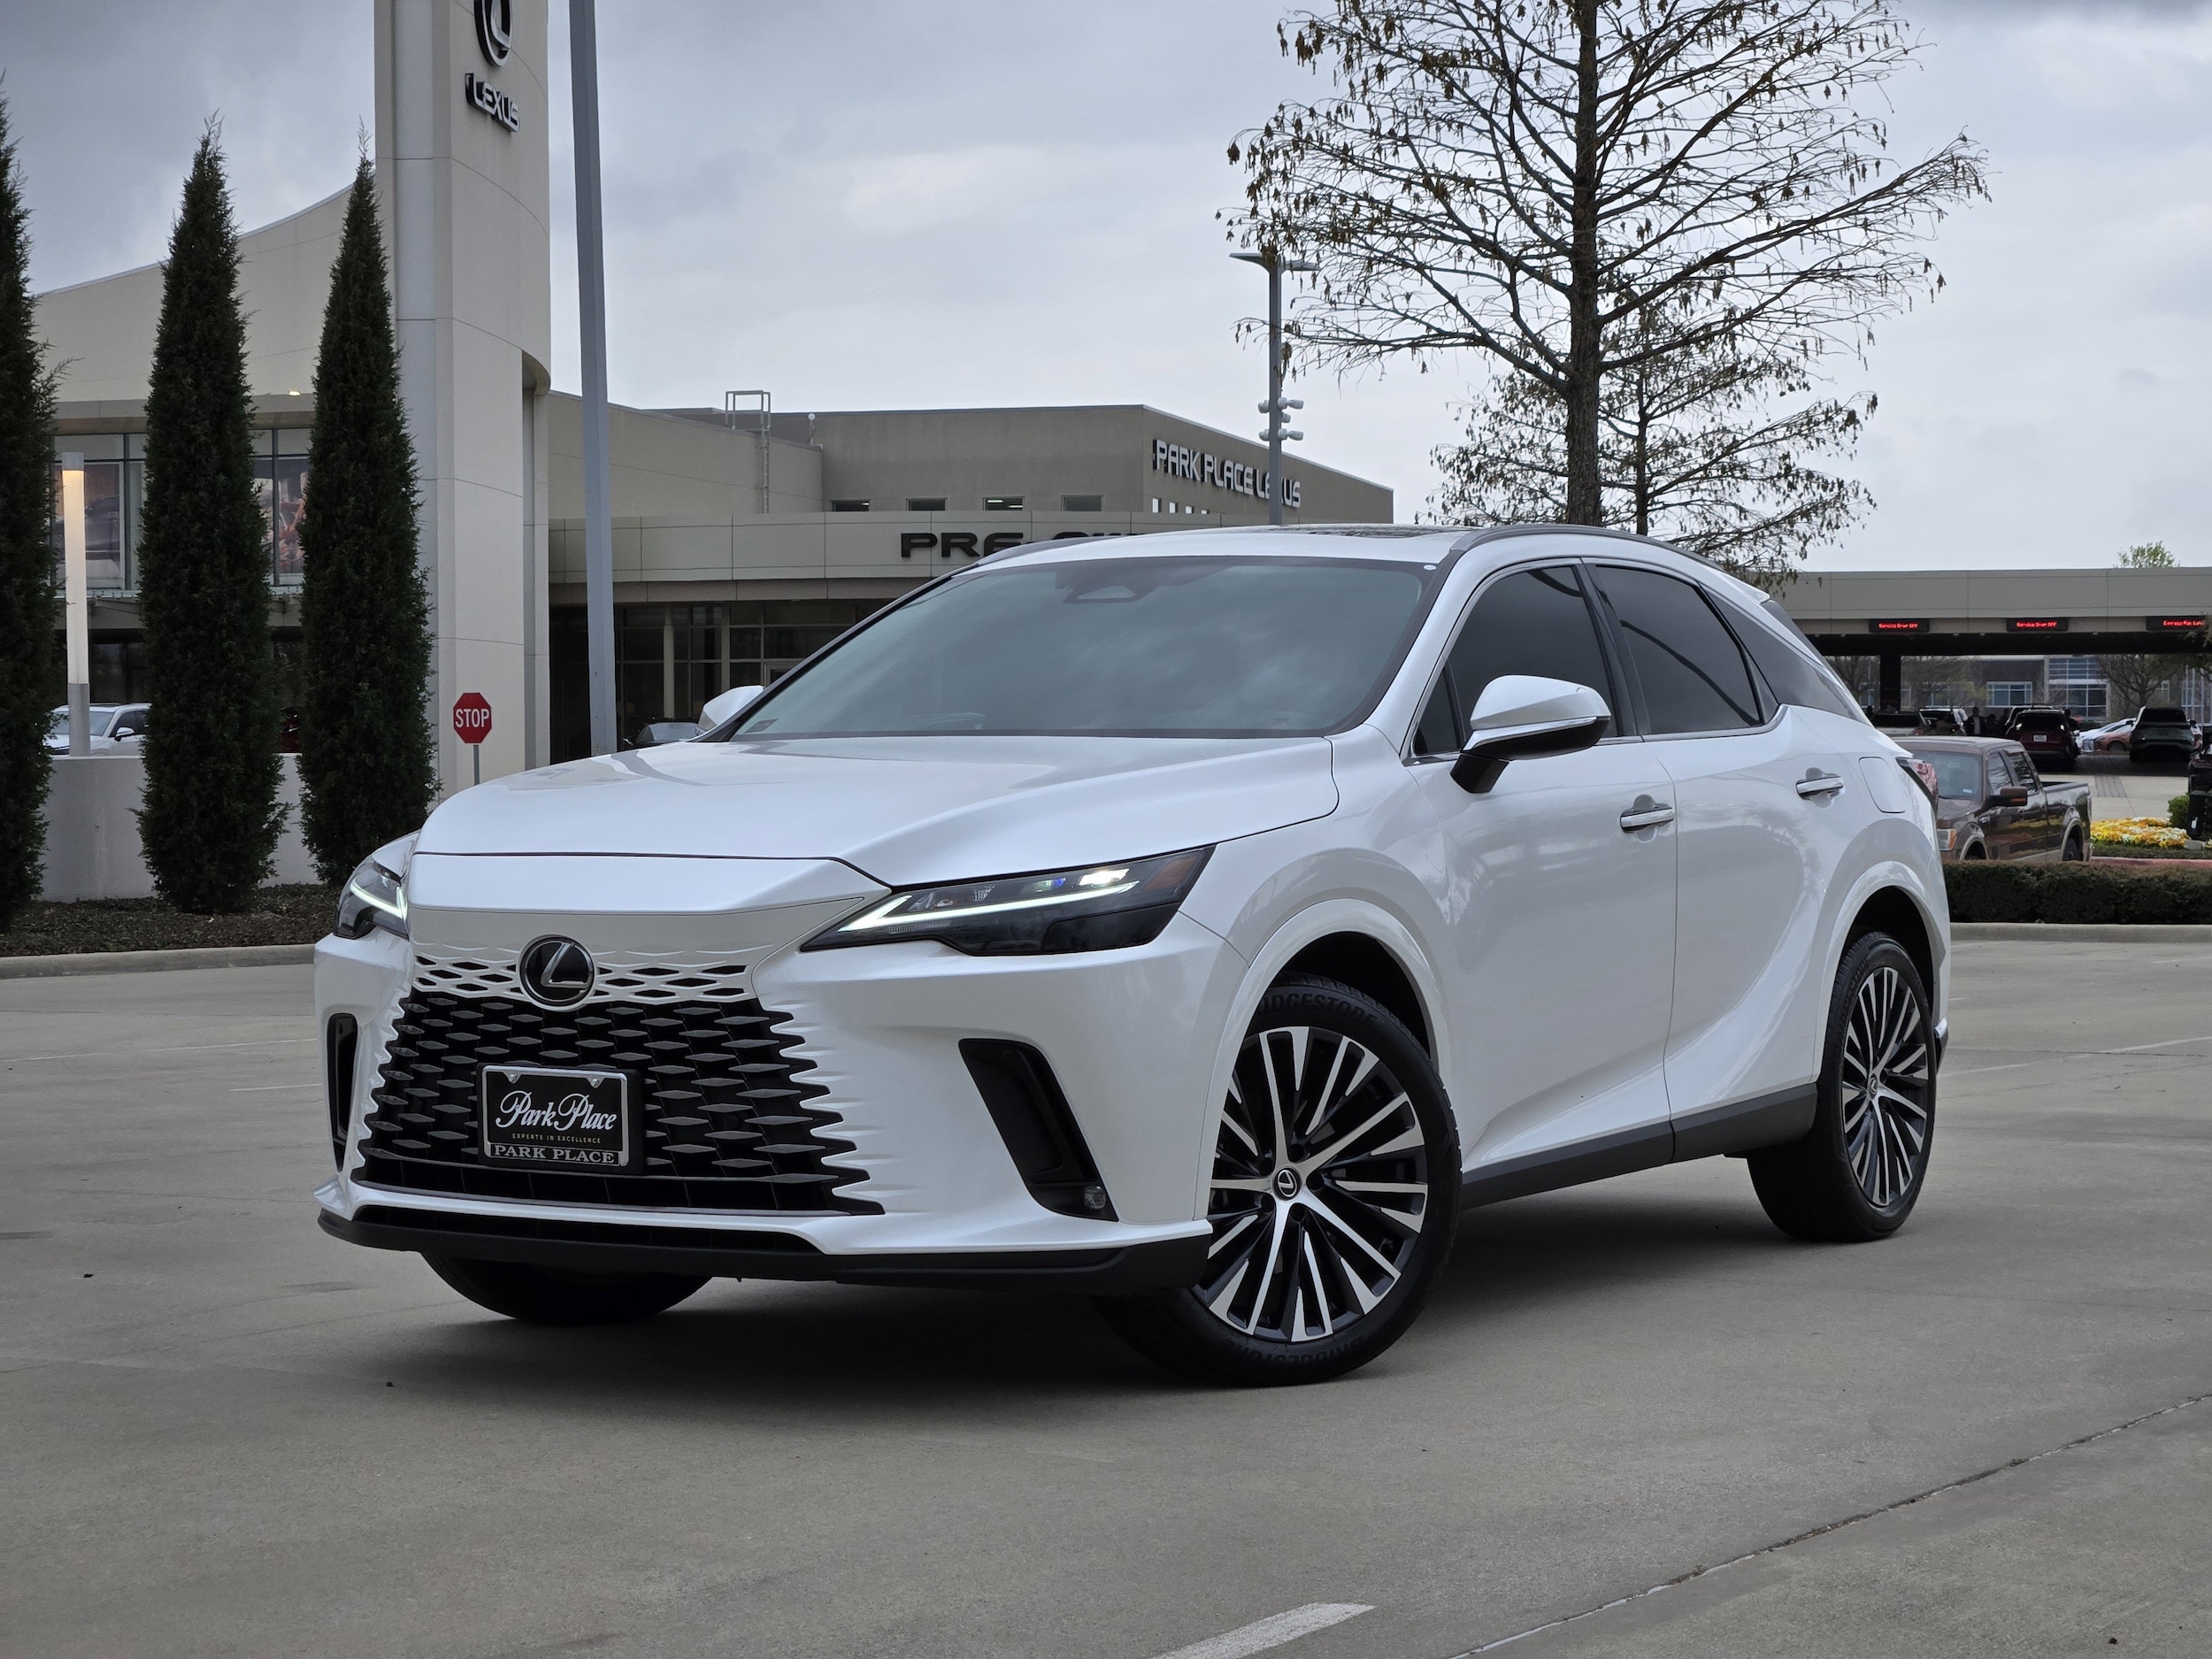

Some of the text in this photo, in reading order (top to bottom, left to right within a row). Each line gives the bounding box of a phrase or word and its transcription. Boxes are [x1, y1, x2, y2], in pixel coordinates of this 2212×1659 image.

[465, 73, 520, 133] LEXUS
[1153, 439, 1302, 508] PARK PLACE LEUS
[455, 708, 490, 728] STOP
[495, 1090, 618, 1131] Park Place
[494, 1145, 615, 1164] PARK PLACE
[557, 1135, 602, 1144] EXCELLENCE
